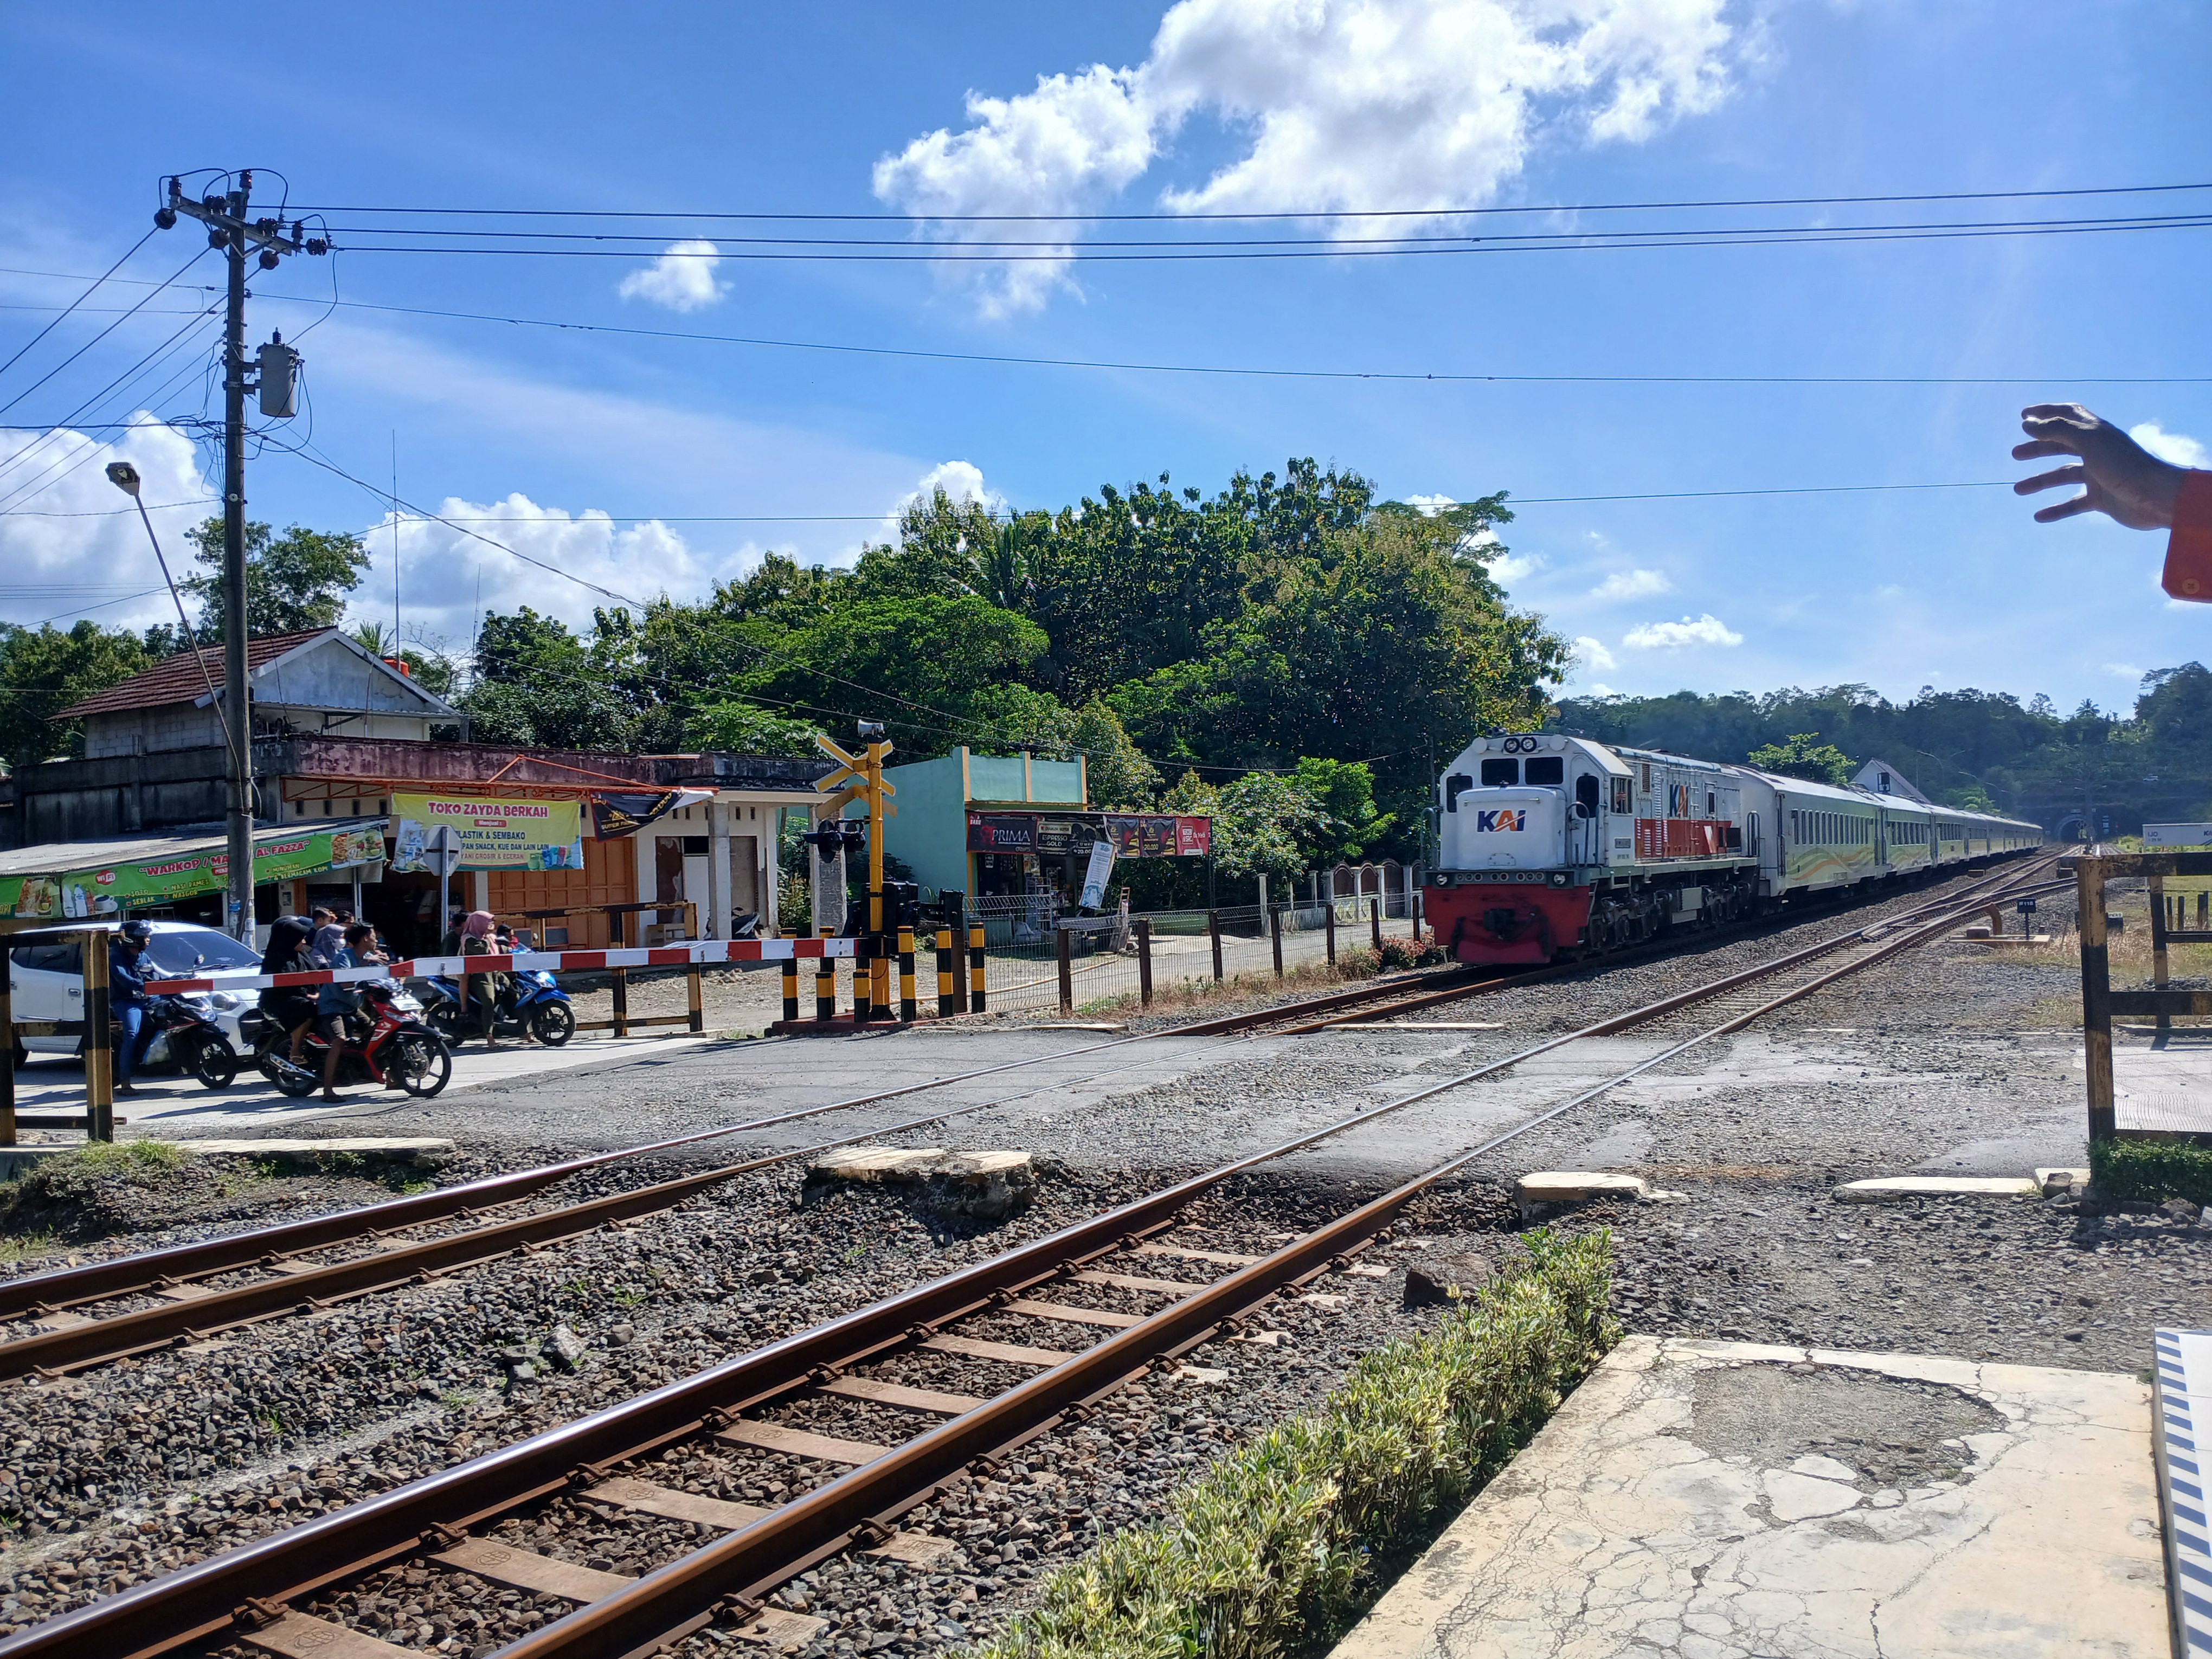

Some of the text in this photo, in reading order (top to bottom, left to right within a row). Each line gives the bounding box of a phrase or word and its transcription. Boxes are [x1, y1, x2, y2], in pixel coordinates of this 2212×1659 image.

[1670, 784, 1689, 817] KAI
[427, 801, 461, 815] TOKO
[463, 803, 501, 816] ZAYDA
[1476, 809, 1527, 833] KAI
[493, 832, 525, 840] SEMBAKO
[992, 829, 1031, 842] PRIMA
[256, 848, 269, 857] AL
[0, 904, 11, 915] OPI
